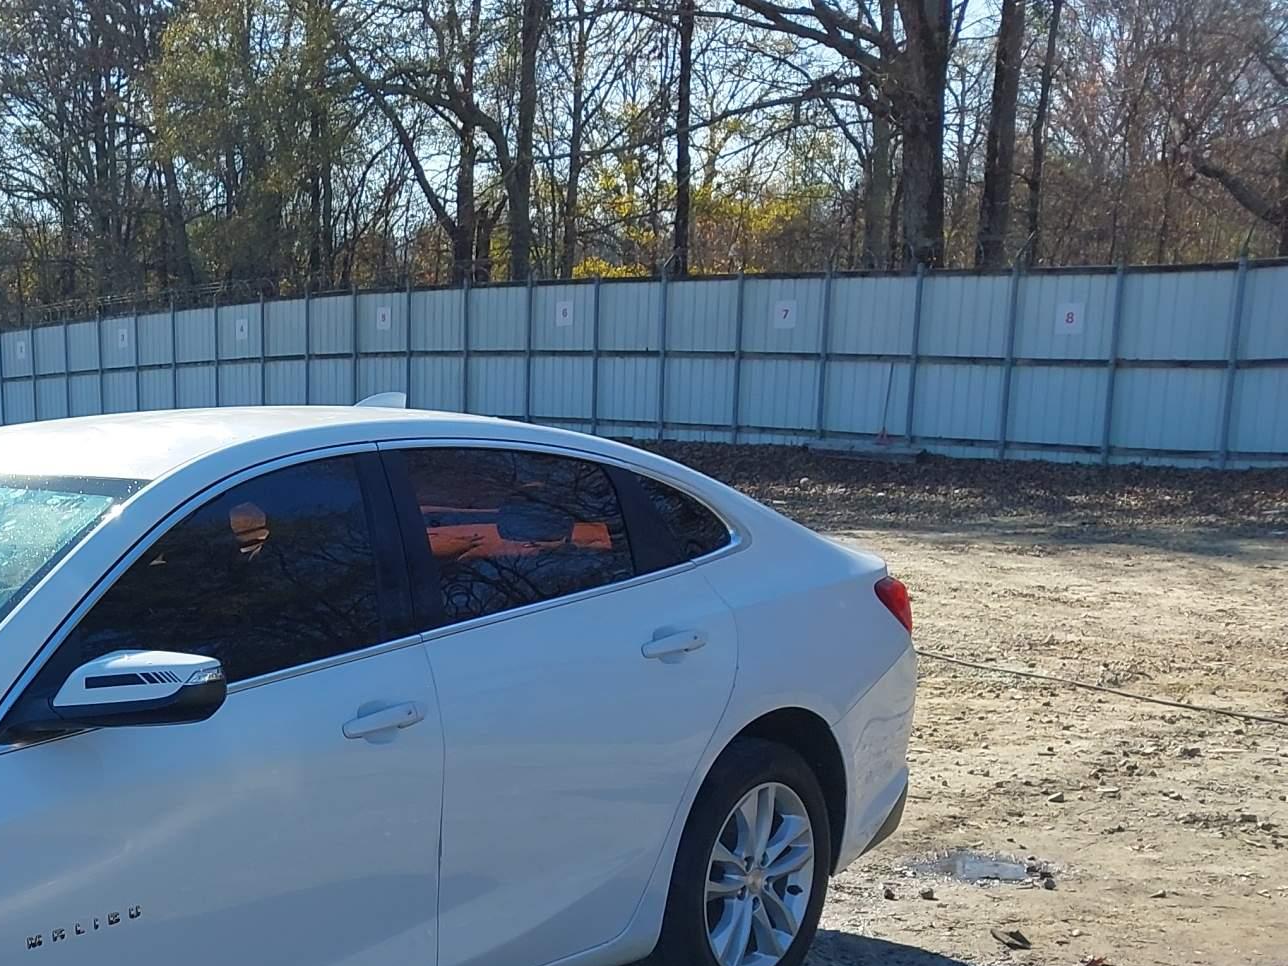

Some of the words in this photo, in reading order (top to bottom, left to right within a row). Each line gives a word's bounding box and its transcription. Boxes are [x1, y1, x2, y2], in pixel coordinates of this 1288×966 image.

[783, 308, 789, 319] 7
[1065, 311, 1074, 324] 8
[26, 904, 142, 950] MALIBU
